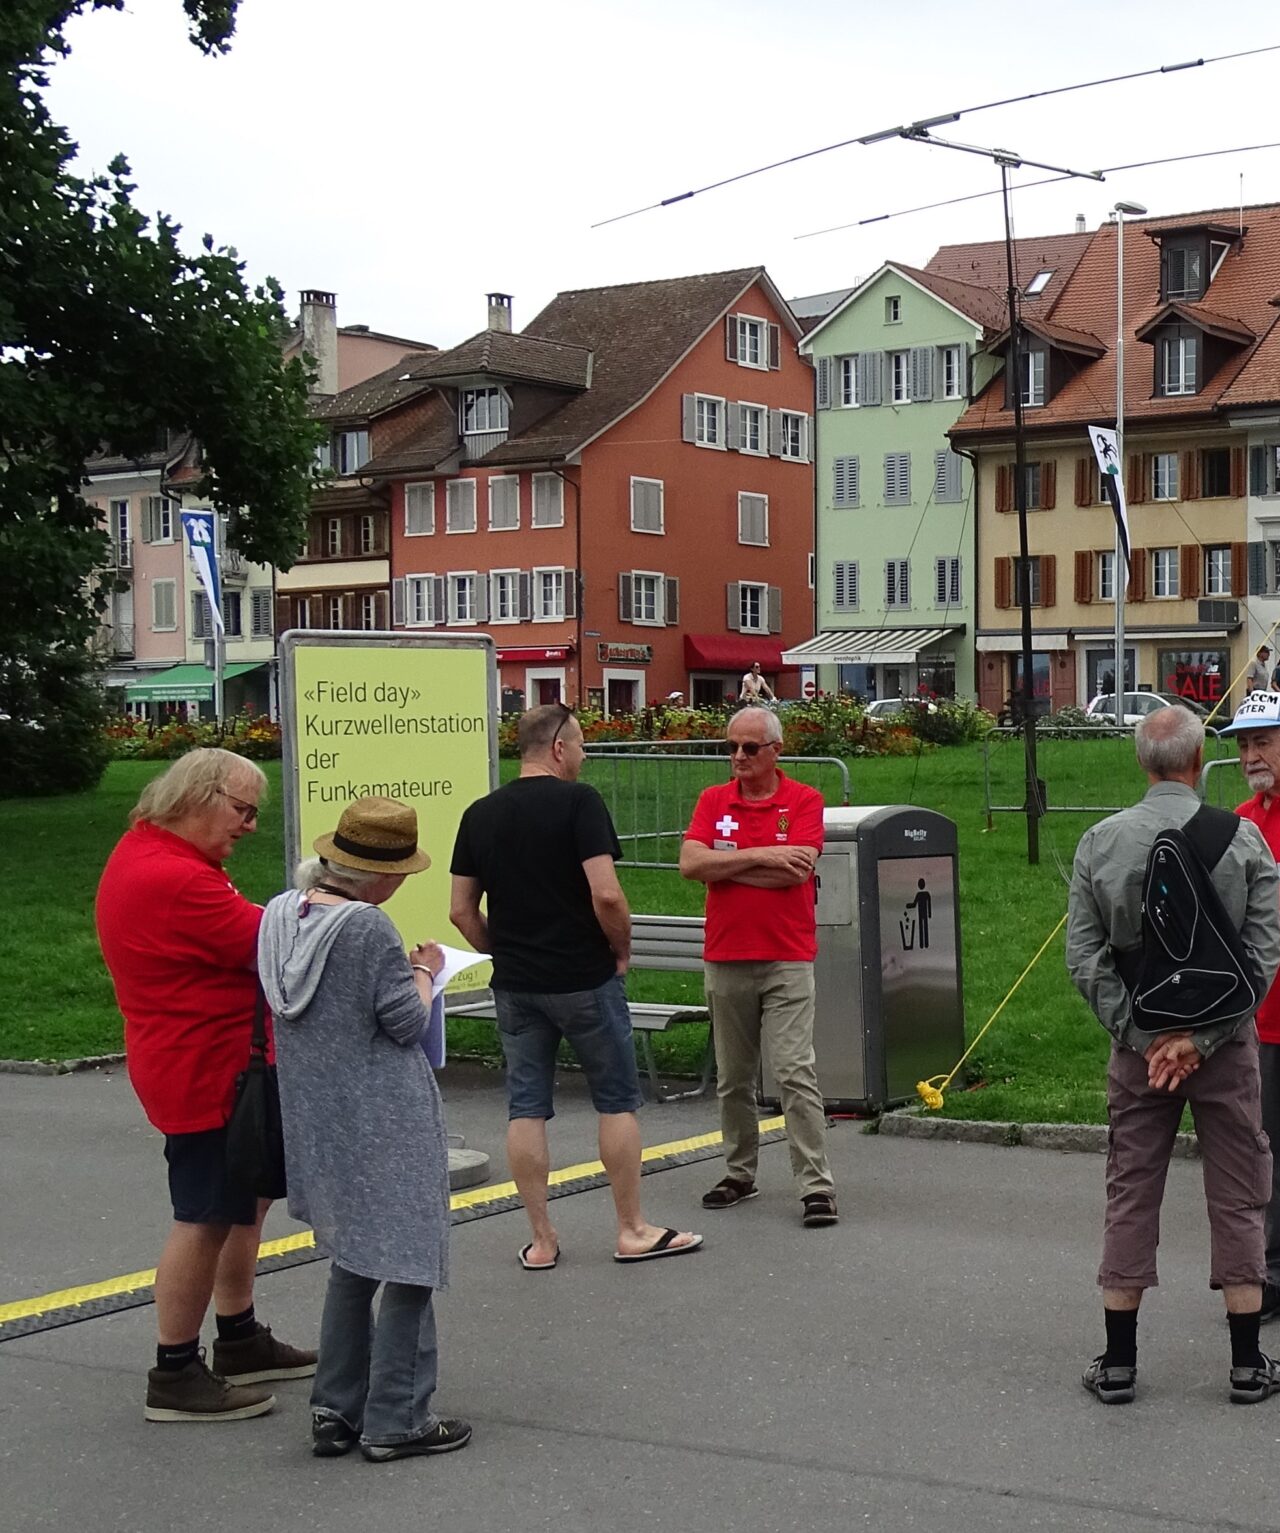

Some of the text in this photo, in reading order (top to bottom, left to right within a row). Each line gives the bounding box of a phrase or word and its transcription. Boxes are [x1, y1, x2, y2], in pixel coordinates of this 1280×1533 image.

[304, 681, 421, 709] «Field day»
[1166, 673, 1222, 700] SALE
[305, 713, 485, 737] Kurzwellenstation
[305, 748, 340, 770] der
[307, 779, 453, 803] Funkamateure
[457, 971, 474, 982] Zug
